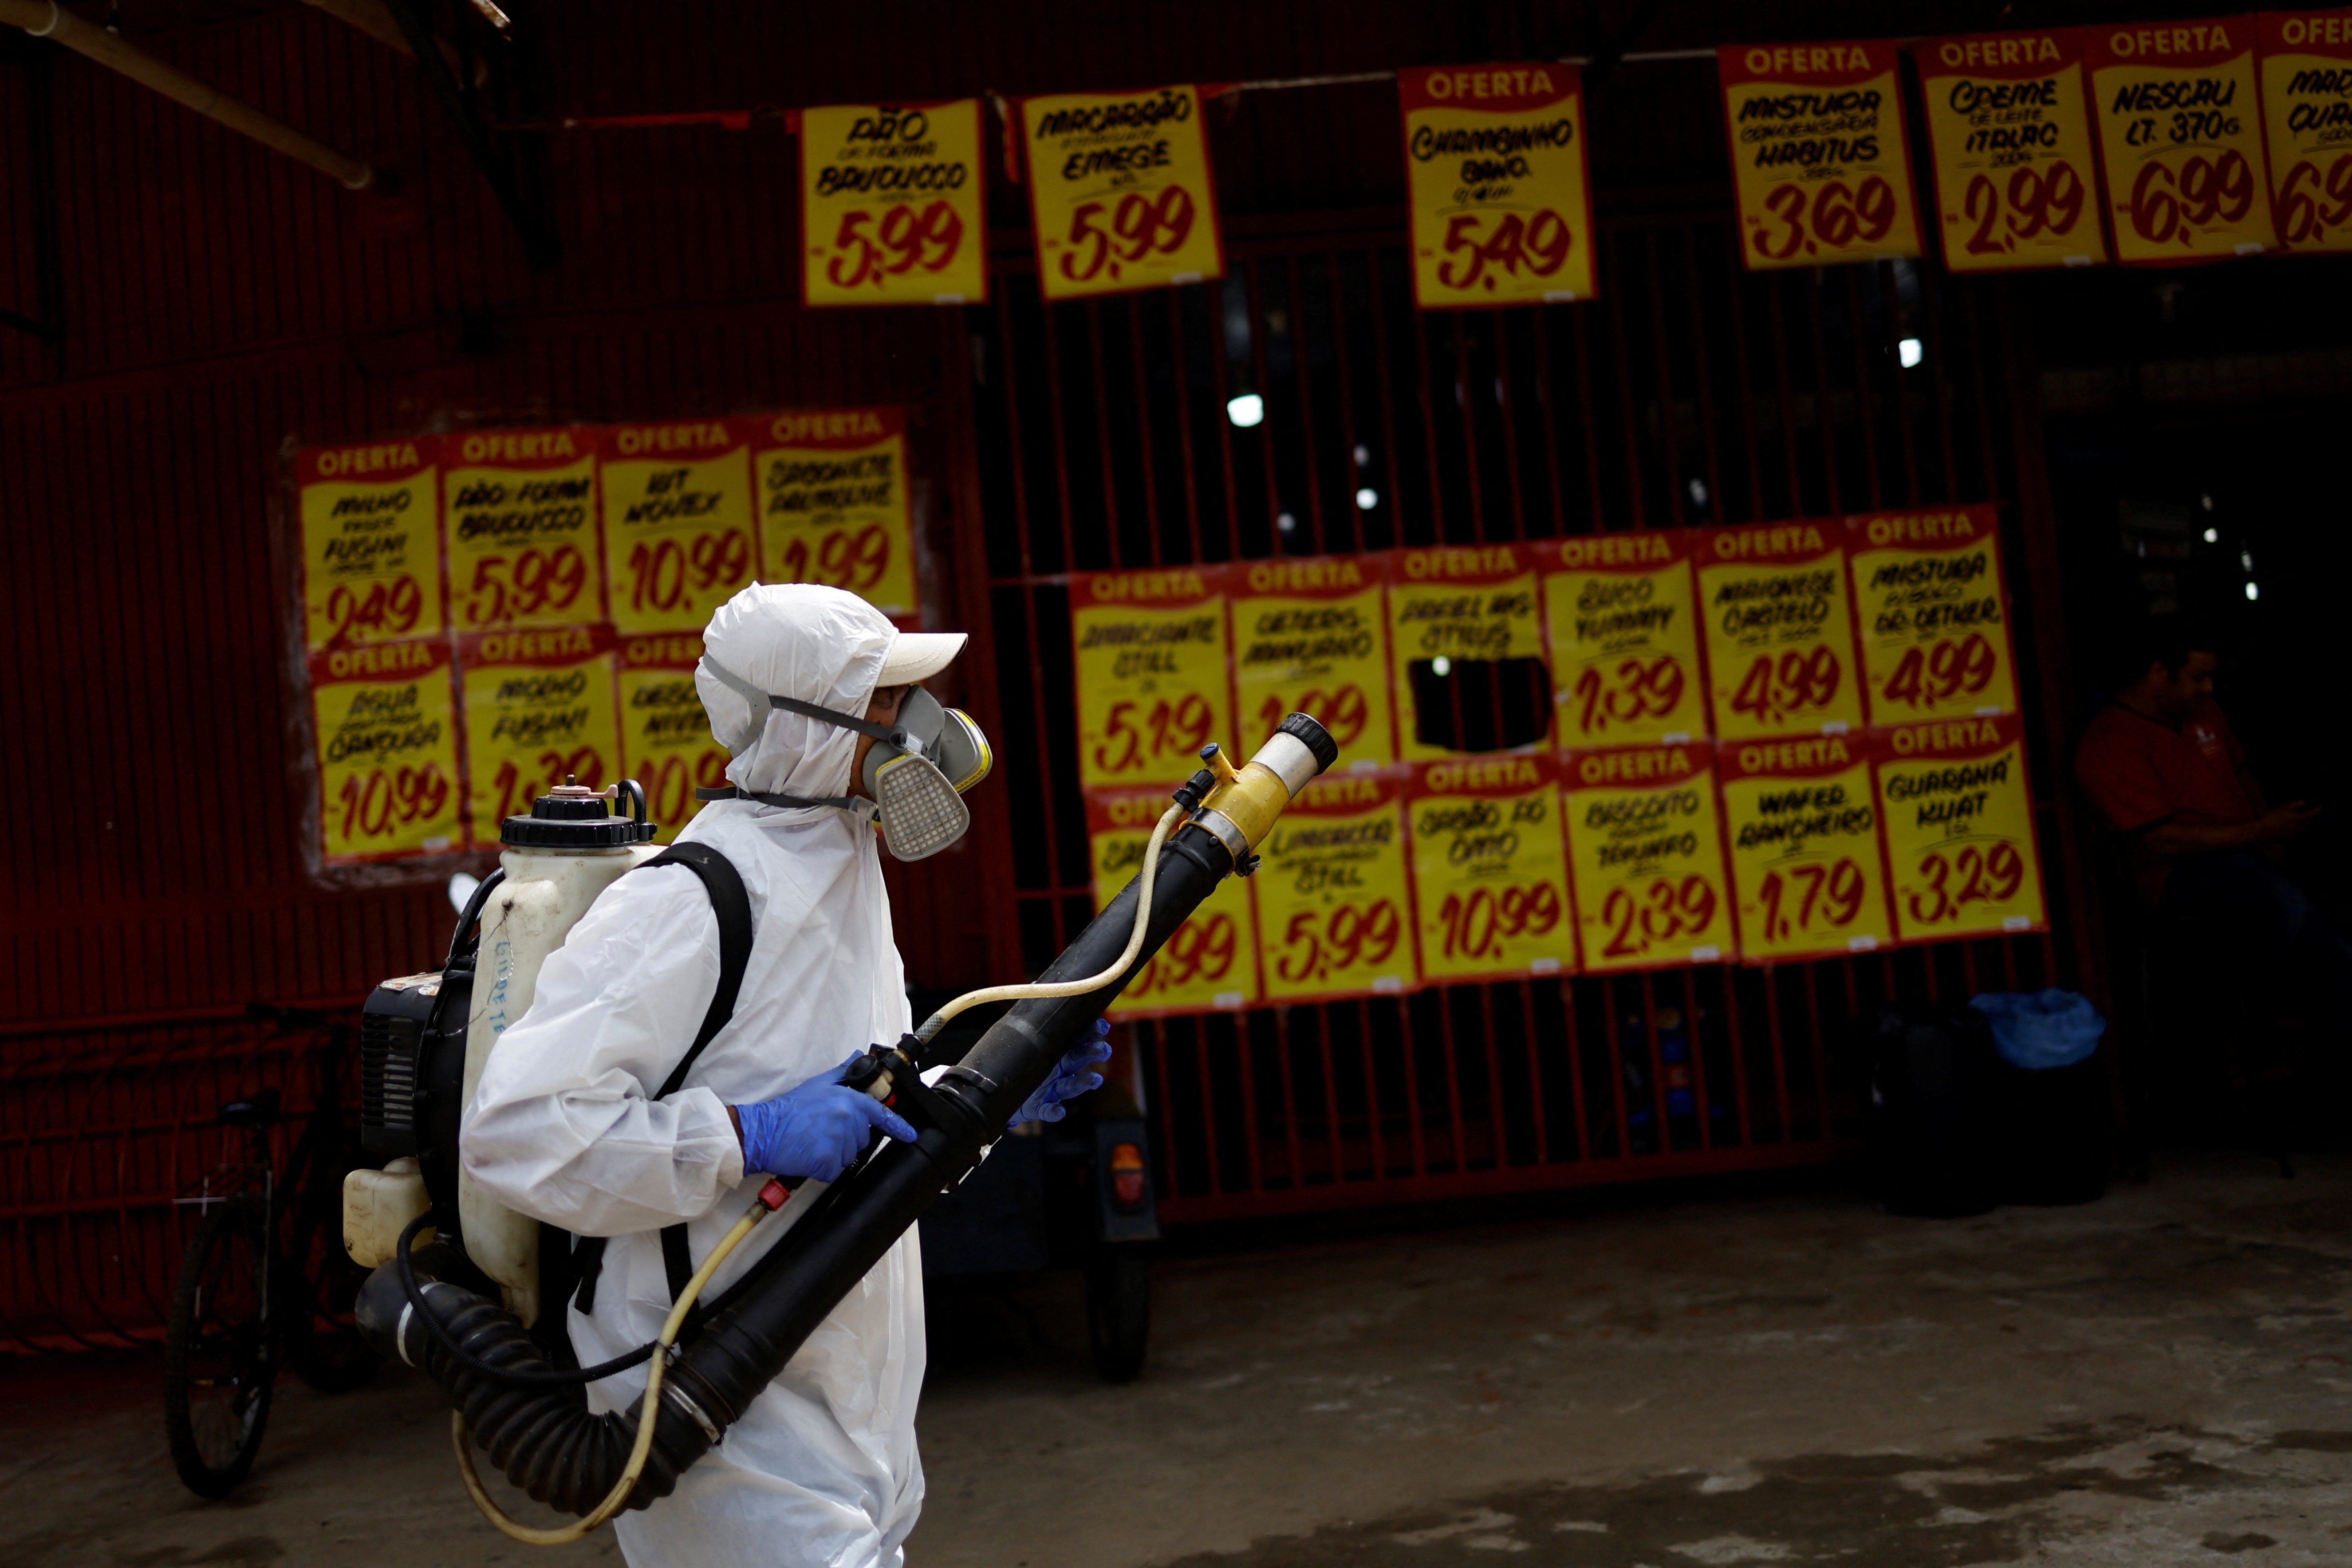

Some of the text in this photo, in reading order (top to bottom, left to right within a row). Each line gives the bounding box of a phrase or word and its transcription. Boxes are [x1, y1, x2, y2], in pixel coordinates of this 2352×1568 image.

[2109, 25, 2231, 57] OFERTA
[2281, 18, 2352, 45] OFER
[1744, 46, 1871, 75] OFERTA
[1939, 36, 2061, 67] OFERTA
[1426, 69, 1555, 100] OFERTA
[1950, 79, 2057, 114] CREME
[2113, 80, 2235, 113] NESCAU
[1037, 90, 1191, 139] MACARRÃO
[1739, 90, 1879, 122] MISTURA
[1995, 108, 2043, 124] LEITE
[847, 107, 928, 144] PÃO
[1412, 118, 1572, 161] CHAMBINHO
[1967, 122, 2057, 152] ITALAC
[1063, 139, 1170, 180] EMEGE
[1756, 135, 1879, 167] HABITUS
[816, 163, 966, 196] BAUDUCCO
[1965, 161, 2084, 255] 2,99
[2131, 149, 2253, 248] 6,99
[2275, 154, 2352, 243] 6,9
[1060, 185, 1194, 283] 5,99
[1754, 175, 1895, 259] 3,69
[827, 200, 962, 289] 5,99
[1438, 208, 1570, 293] 5,49
[617, 421, 731, 455] OFERTA
[770, 412, 884, 442] OFERTA
[317, 442, 420, 476] OFERTA
[462, 431, 576, 462] OFERTA
[1713, 525, 1824, 560] OFERTA
[1866, 512, 1975, 546] OFERTA
[1405, 546, 1517, 579] OFERTA
[1560, 534, 1673, 568] OFERTA
[466, 545, 586, 623] 5,99
[629, 528, 749, 613] 10,99
[1091, 570, 1205, 601] OFERTA
[1248, 560, 1362, 592] OFERTA
[1871, 551, 1986, 591] MISTURA
[1577, 578, 1654, 613] SUCO
[329, 642, 433, 676] OFERTA
[481, 629, 593, 661] OFERTA
[626, 636, 705, 664] OFER
[1732, 645, 1840, 727] 4,99
[1883, 632, 1995, 710] 4,99
[1576, 656, 1684, 733] 1,39
[1095, 693, 1213, 773] 5,19
[1891, 718, 2001, 755] OFERTA
[1579, 748, 1691, 783] OFERTA
[1738, 737, 1850, 773] OFERTA
[1425, 758, 1540, 792] OFERTA
[341, 764, 447, 840] 10,99
[1759, 784, 1845, 813] WAFER
[1917, 791, 1987, 829] KUAT
[1737, 807, 1873, 849] RANCHEIRO
[1910, 839, 2022, 923] 3,29
[1603, 875, 1716, 958] 2,39
[1761, 856, 1863, 945] 1,79
[1442, 880, 1560, 959] 10,99
[1278, 900, 1399, 982] 5,99
